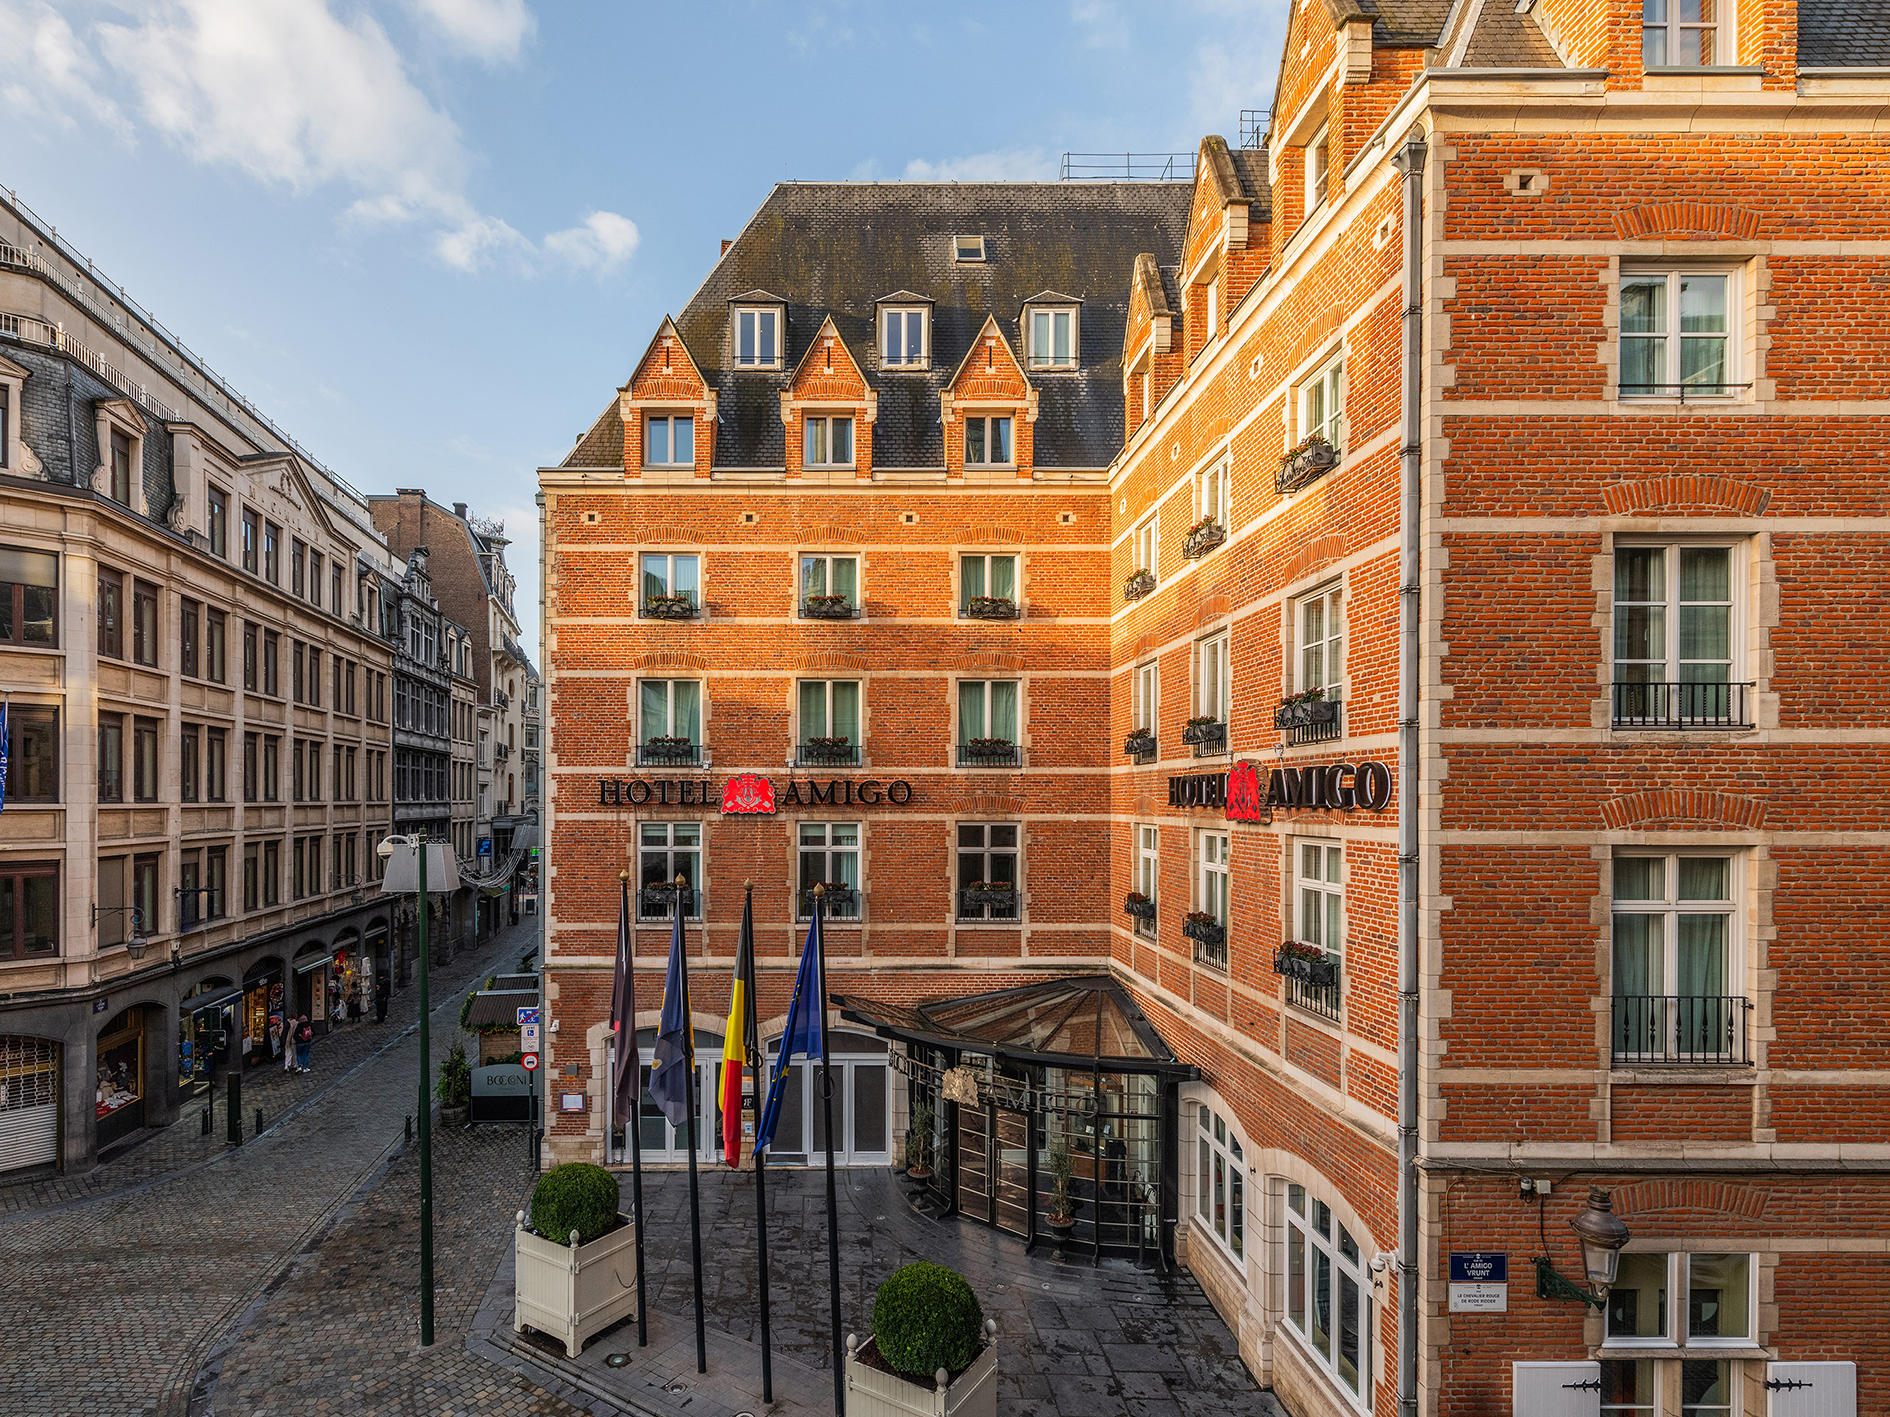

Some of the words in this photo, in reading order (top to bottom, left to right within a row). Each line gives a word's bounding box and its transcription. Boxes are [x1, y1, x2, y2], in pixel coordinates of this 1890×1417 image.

[598, 779, 717, 806] HOTEL
[782, 779, 913, 806] AMIGO
[1167, 772, 1228, 808] HOTEL
[1266, 761, 1392, 811] AMIGO
[486, 1074, 527, 1086] BOCCONI
[982, 1081, 1099, 1120] AMIGO
